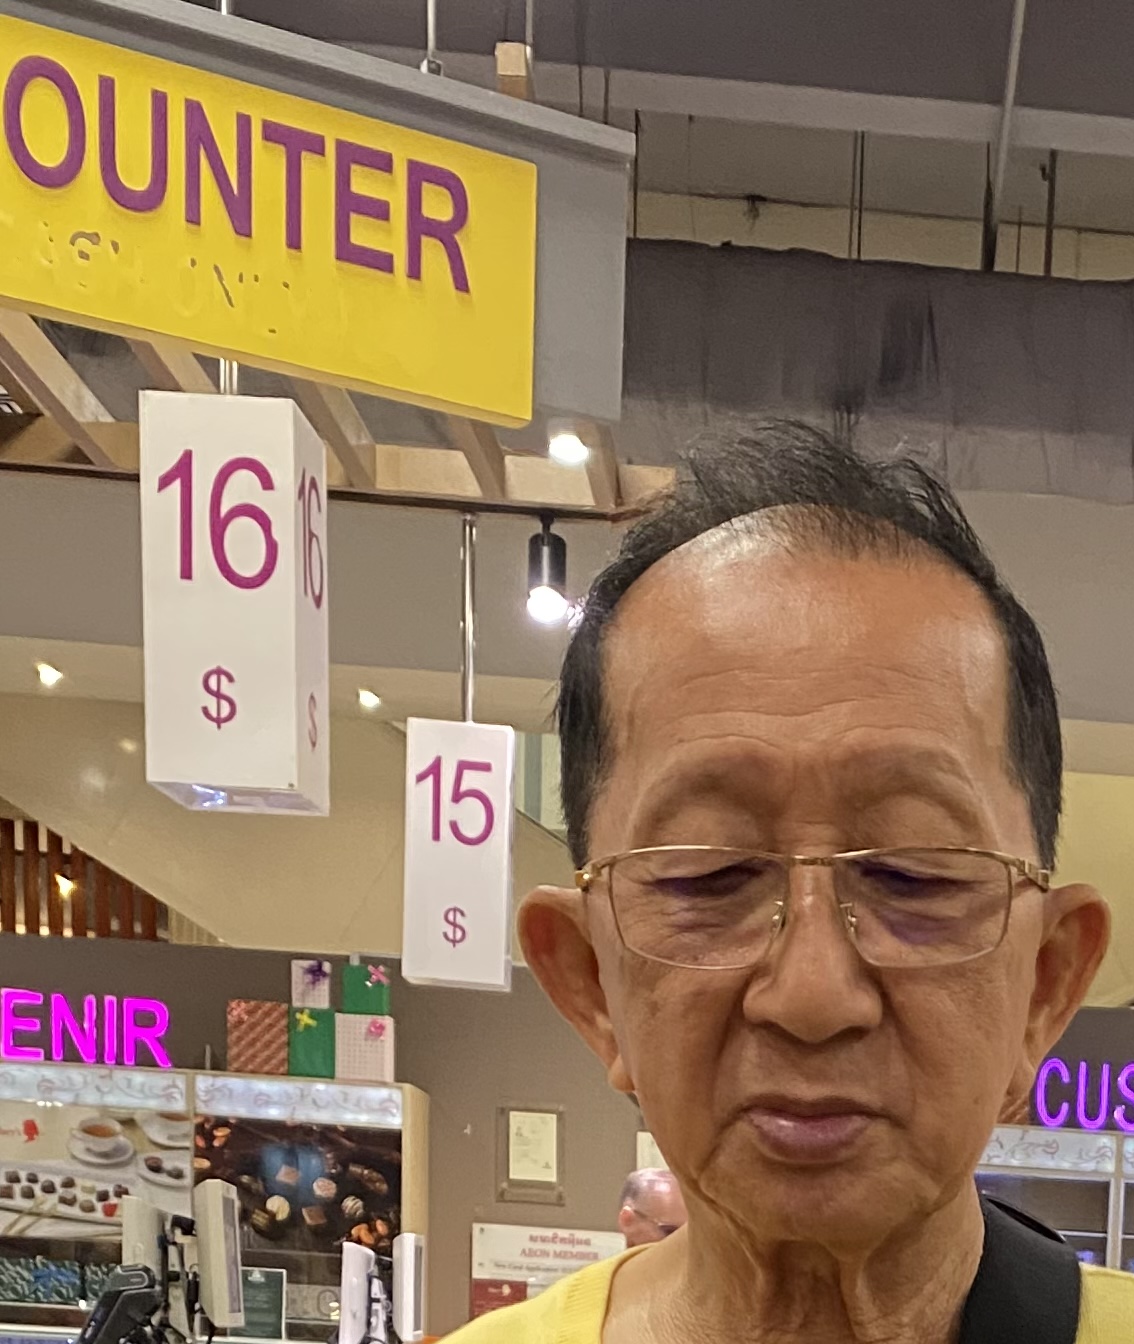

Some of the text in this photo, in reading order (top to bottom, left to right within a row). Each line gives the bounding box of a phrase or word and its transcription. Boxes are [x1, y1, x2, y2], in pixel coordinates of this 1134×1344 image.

[157, 449, 279, 590] 16
[298, 467, 325, 610] 16
[200, 666, 238, 730] $
[415, 755, 495, 846] 15
[442, 906, 467, 948] $
[0, 987, 172, 1069] ENIR
[520, 1248, 600, 1260] AEON MEMBER
